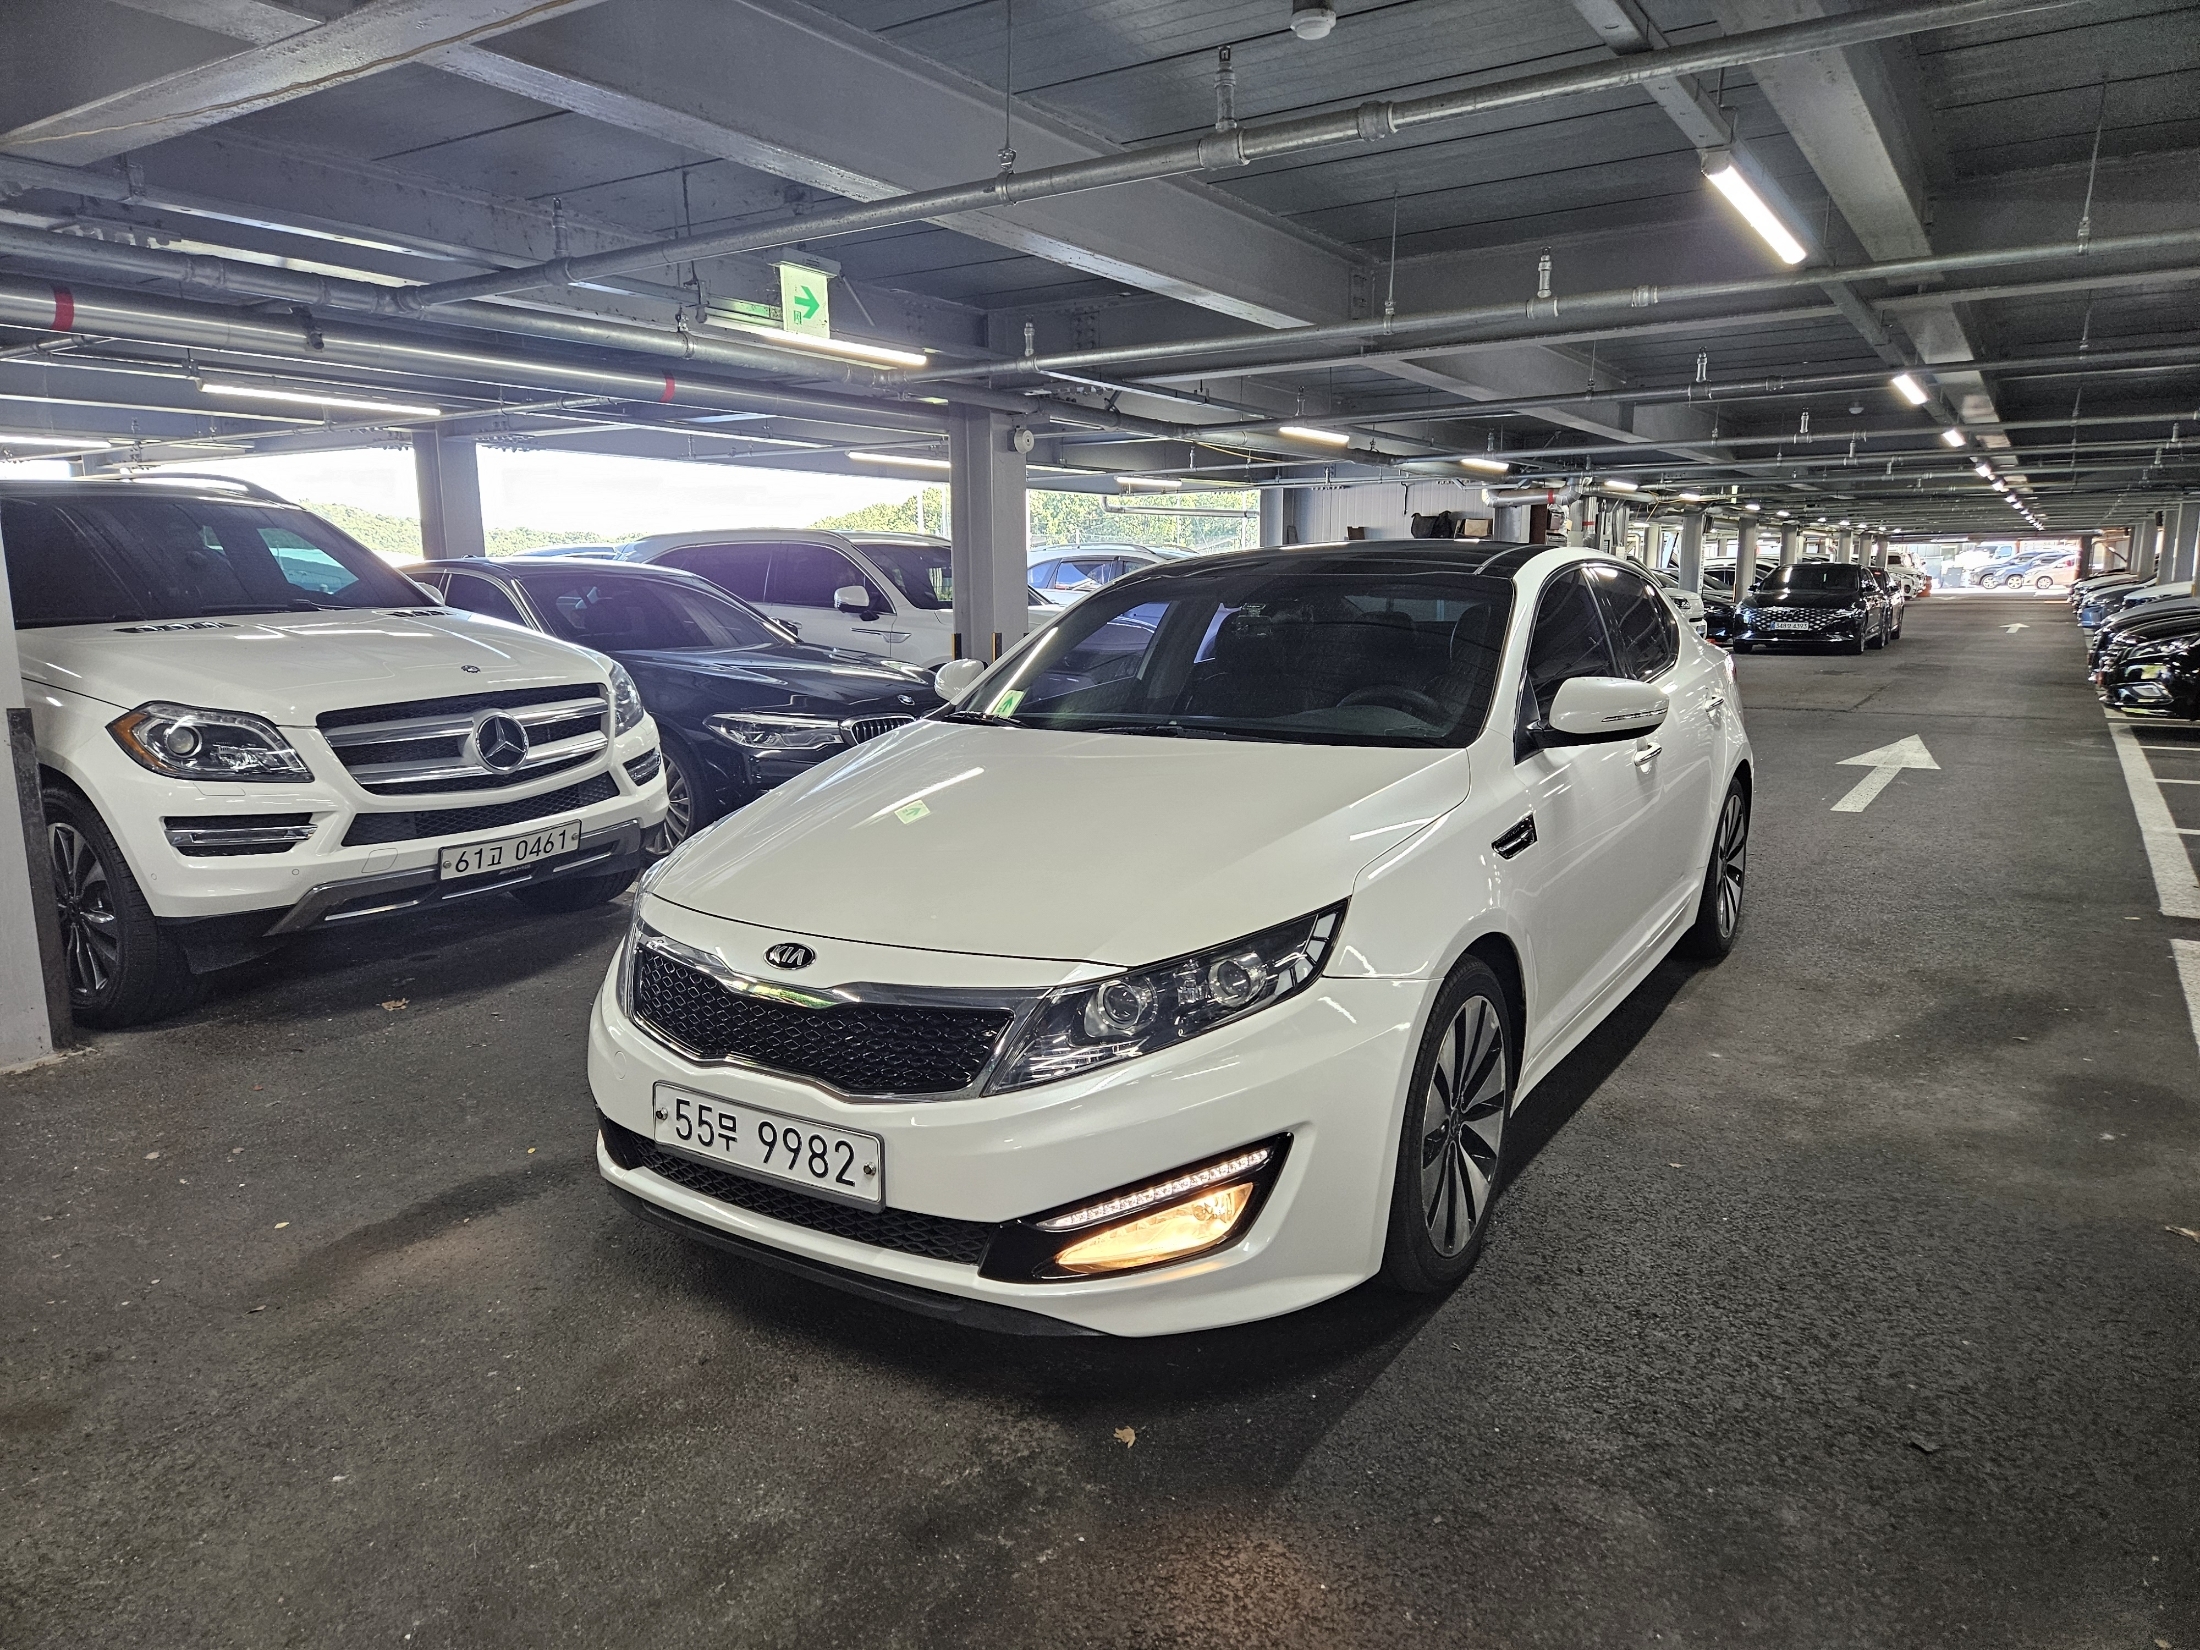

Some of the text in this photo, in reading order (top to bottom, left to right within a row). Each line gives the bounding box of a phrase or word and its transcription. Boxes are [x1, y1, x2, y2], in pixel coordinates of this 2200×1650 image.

[455, 830, 566, 873] 61고 0461
[768, 945, 806, 966] KIA
[675, 1098, 855, 1187] 55무 9982
